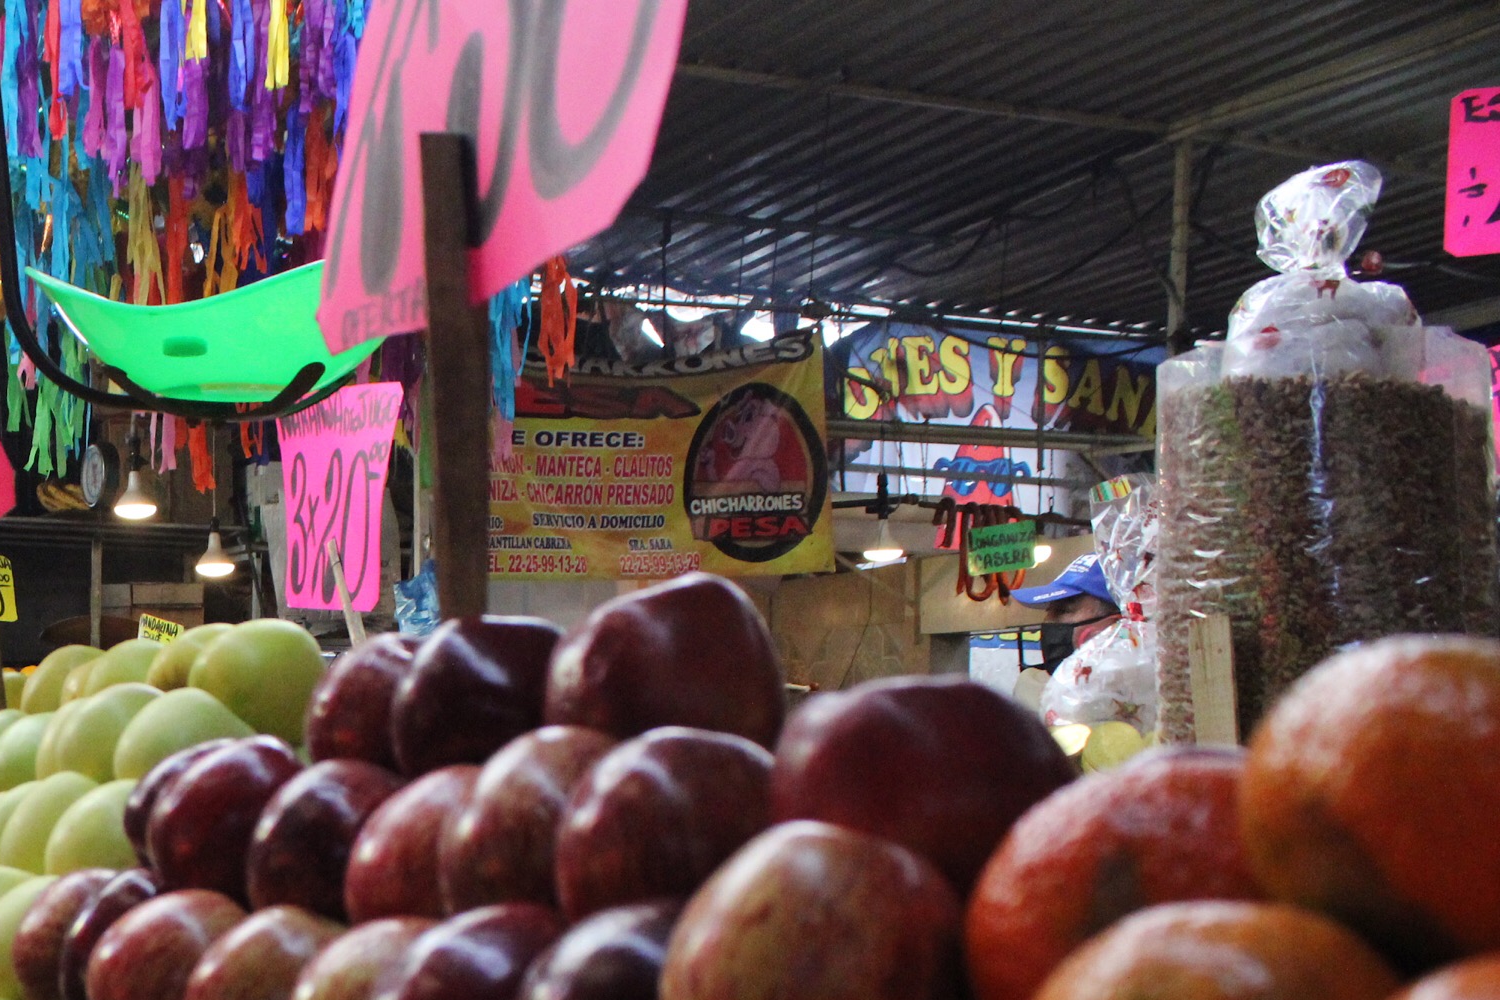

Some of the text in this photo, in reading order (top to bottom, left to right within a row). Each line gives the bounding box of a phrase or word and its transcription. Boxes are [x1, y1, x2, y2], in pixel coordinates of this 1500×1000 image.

[987, 336, 1027, 397] Y
[1043, 346, 1157, 437] SAN
[511, 430, 644, 448] E OFRECE:
[536, 454, 602, 478] MANTECA
[613, 456, 674, 478] CLALITOS
[526, 480, 603, 505] CHICARRÓN
[607, 484, 674, 505] PRENSADO
[690, 493, 803, 515] CHICHARRONES
[533, 513, 666, 529] SERVICIO A DOMICILIO
[708, 515, 809, 538] PESA
[488, 537, 573, 550] ANTILLAN CABRERA
[975, 547, 1031, 570] CASERA
